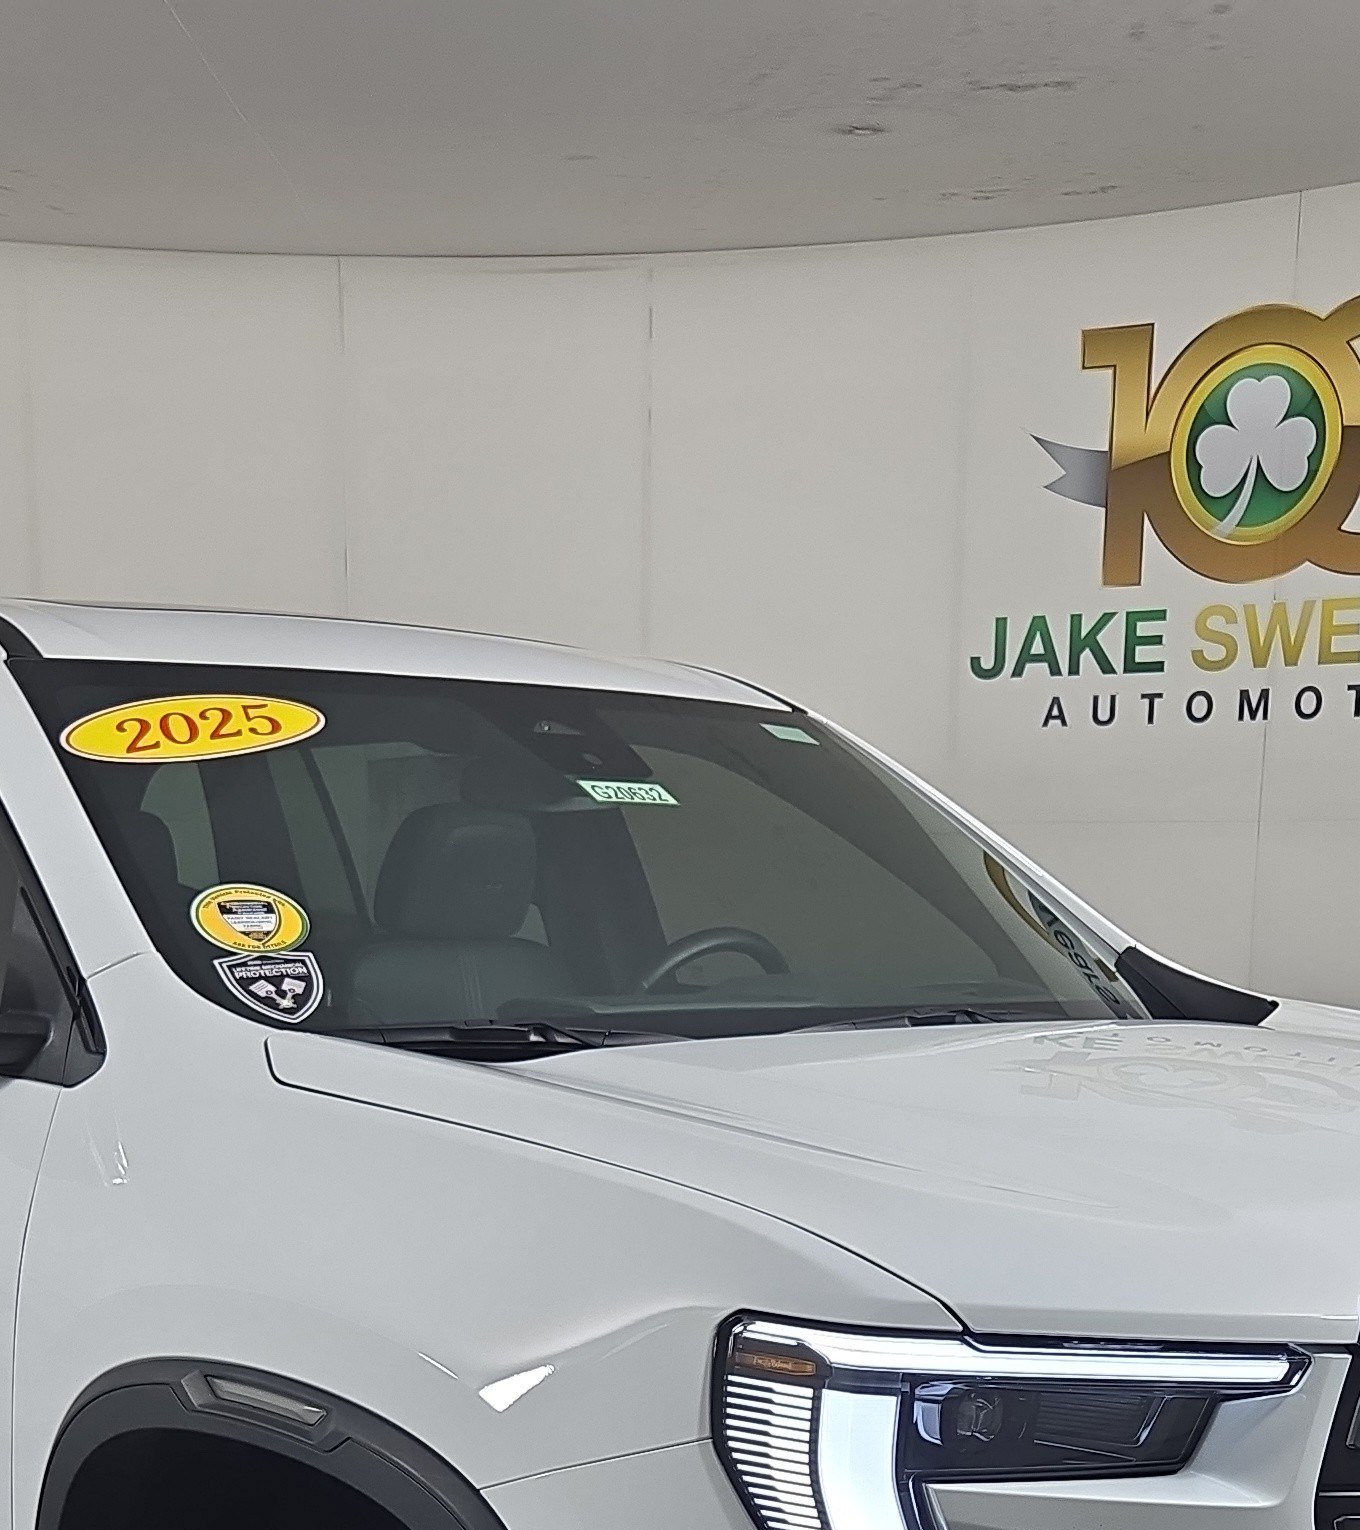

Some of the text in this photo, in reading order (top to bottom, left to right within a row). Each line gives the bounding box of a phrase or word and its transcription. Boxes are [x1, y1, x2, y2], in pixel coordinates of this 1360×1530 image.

[969, 608, 1169, 682] JAKE
[115, 703, 283, 755] 2025
[590, 784, 670, 803] G20632
[234, 965, 310, 980] PROTECTION
